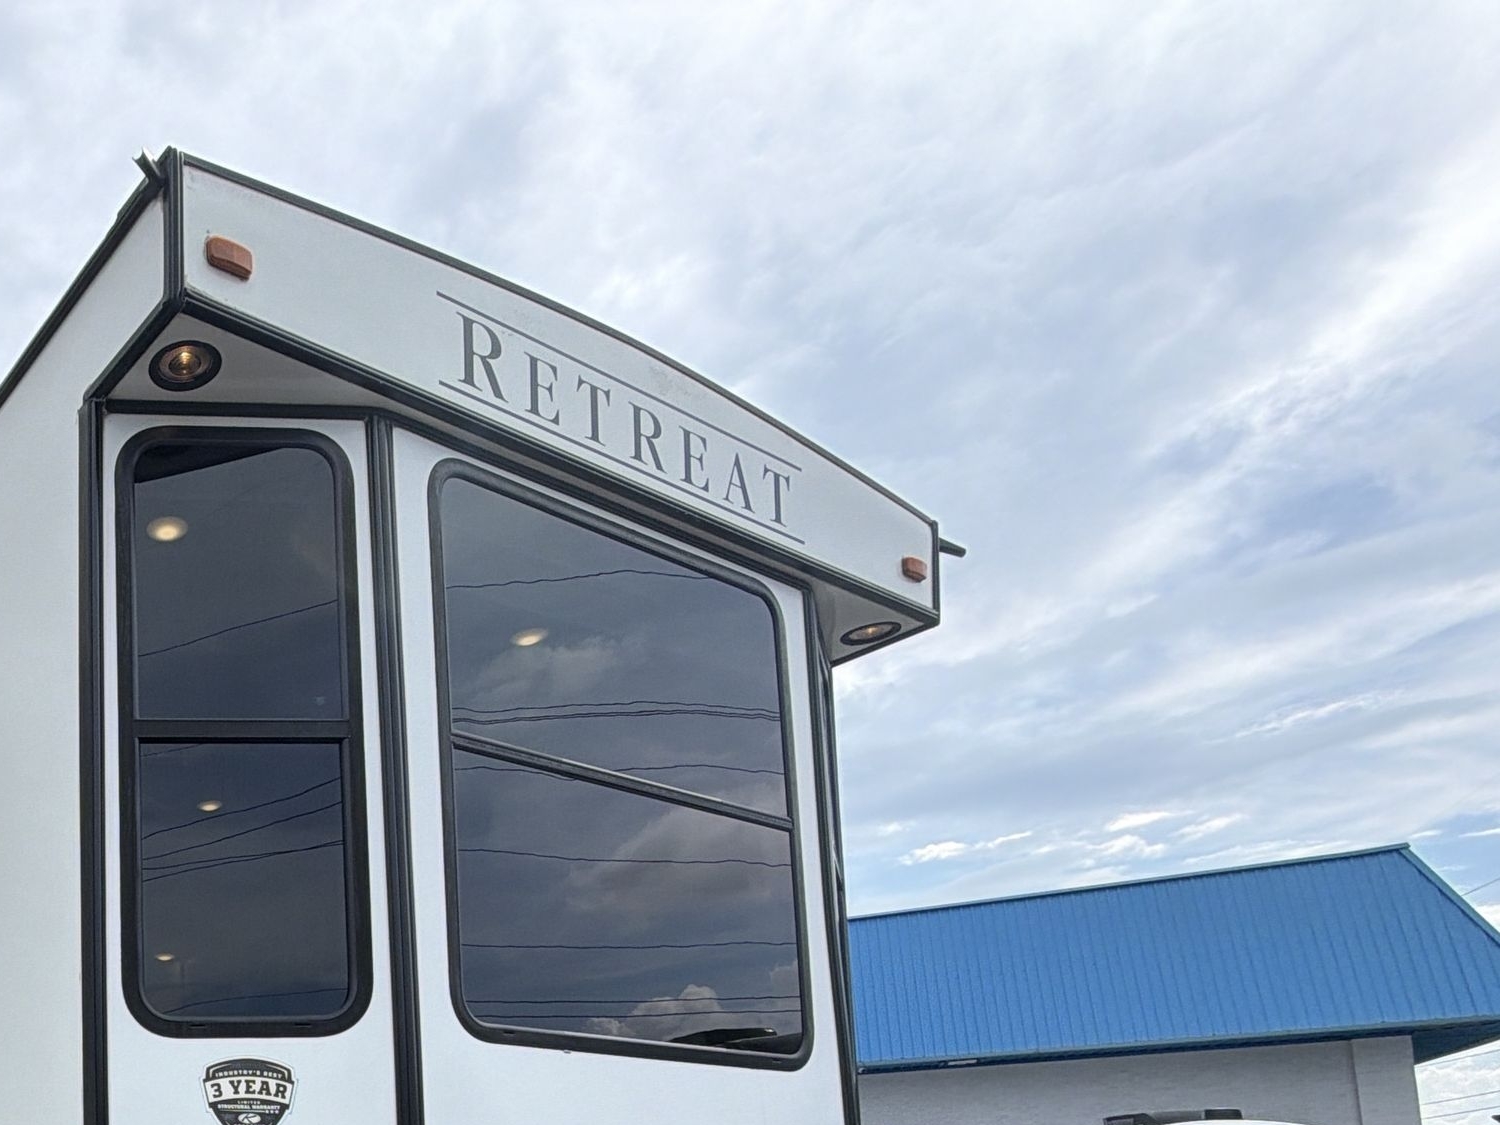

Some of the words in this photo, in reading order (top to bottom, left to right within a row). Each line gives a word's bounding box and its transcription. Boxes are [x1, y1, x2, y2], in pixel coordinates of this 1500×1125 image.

[456, 311, 791, 528] RETREAT
[215, 1069, 261, 1078] INDUSTRY'S
[263, 1070, 283, 1079] BEST
[210, 1082, 223, 1099] 3
[228, 1079, 288, 1100] YEAR
